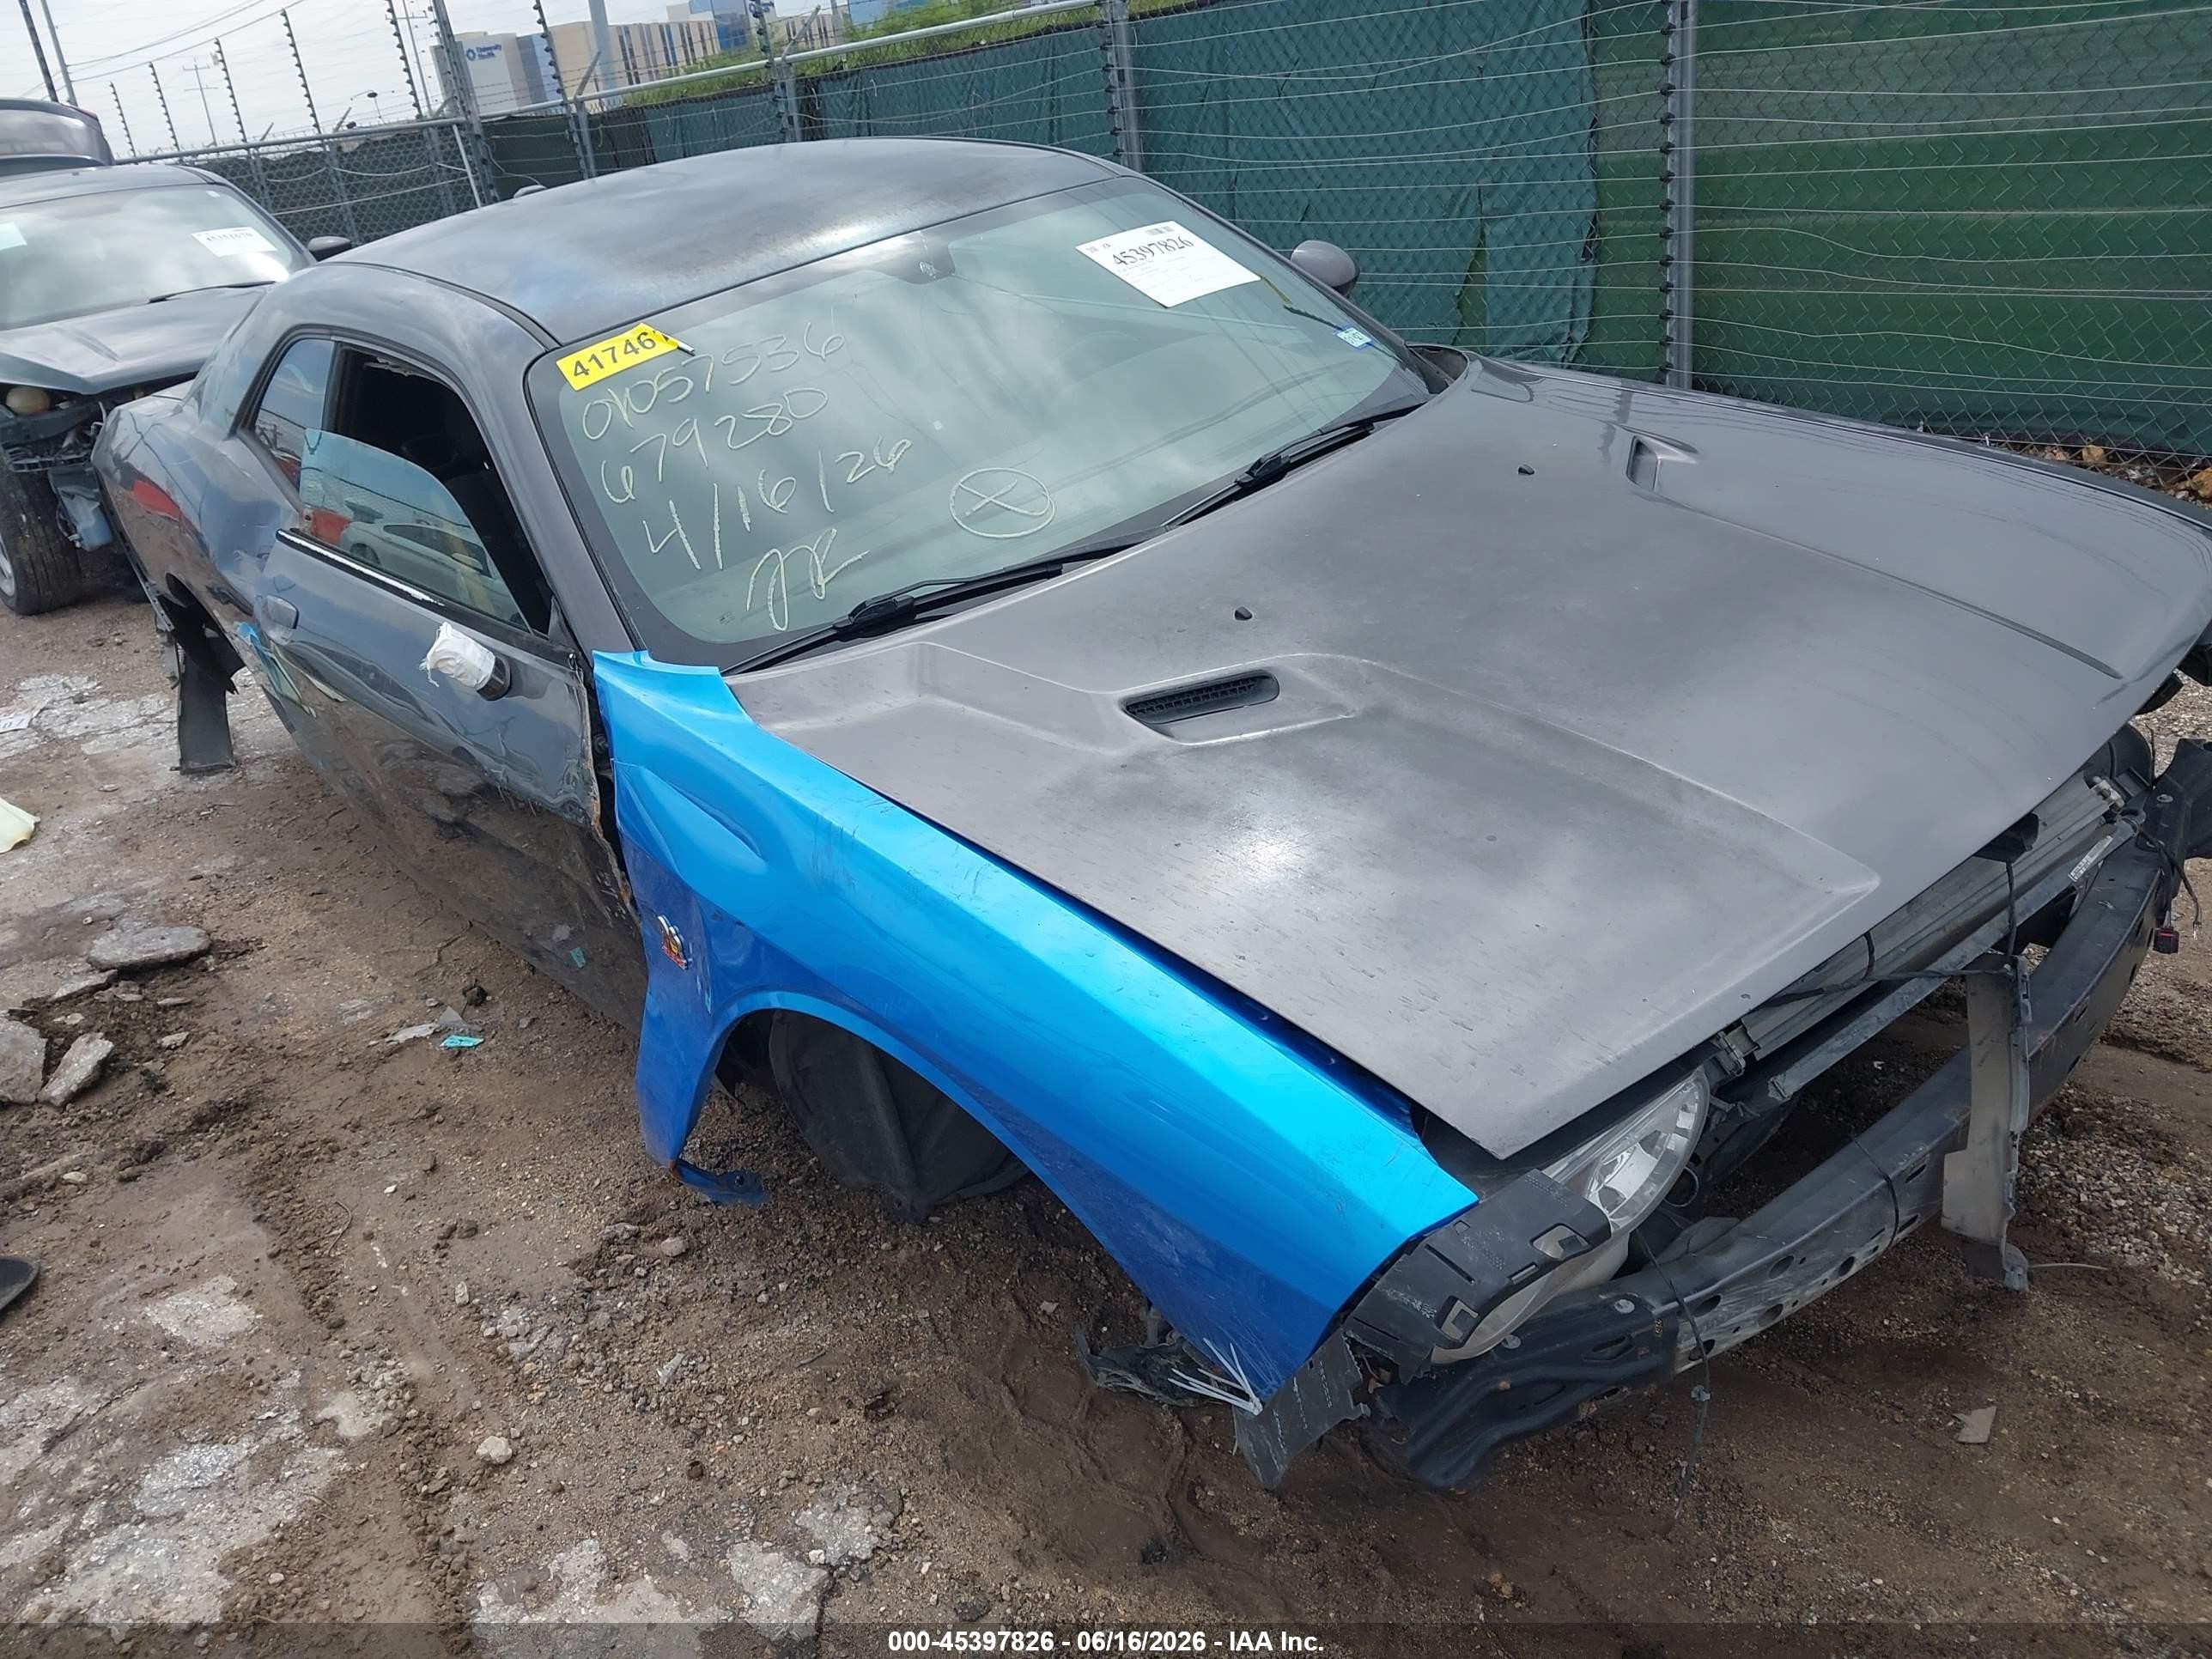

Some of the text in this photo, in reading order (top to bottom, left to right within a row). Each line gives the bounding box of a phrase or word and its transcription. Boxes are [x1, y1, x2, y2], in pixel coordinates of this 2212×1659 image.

[1113, 236, 1194, 266] 45397826
[601, 387, 828, 505] 679280
[642, 434, 913, 571] 4/16/26
